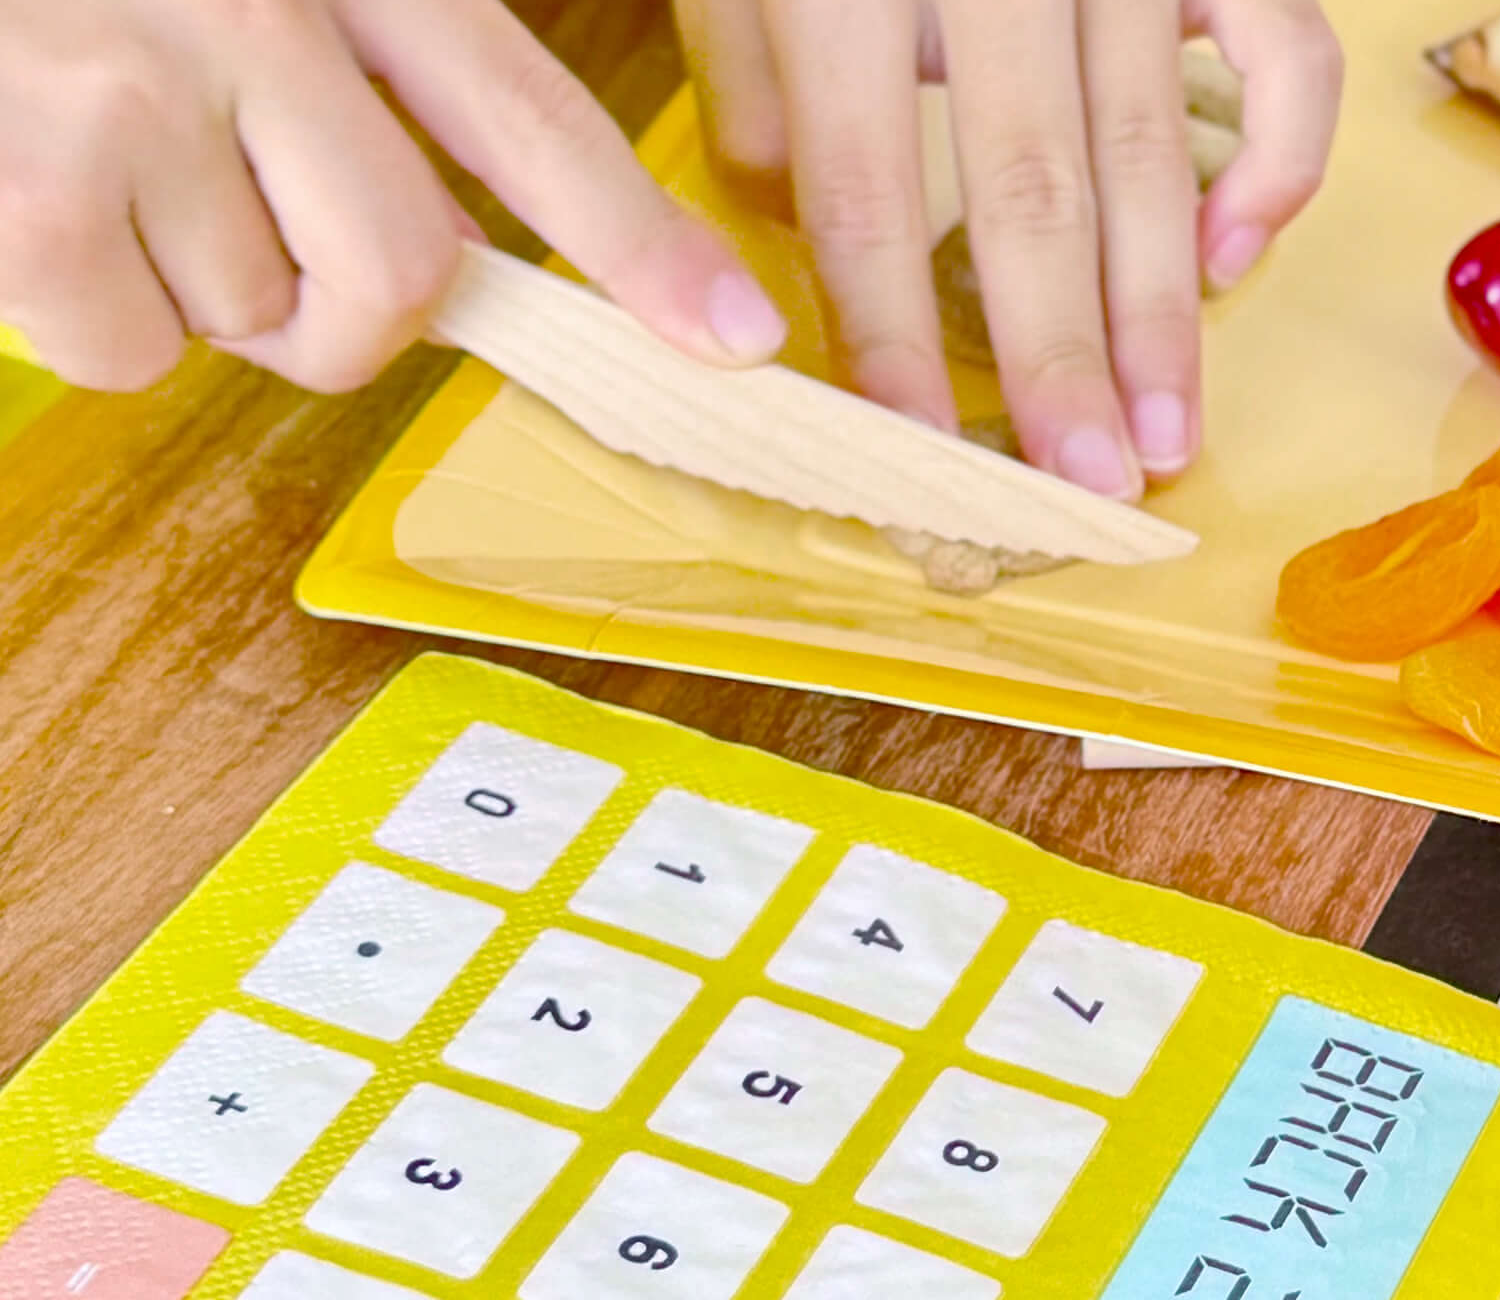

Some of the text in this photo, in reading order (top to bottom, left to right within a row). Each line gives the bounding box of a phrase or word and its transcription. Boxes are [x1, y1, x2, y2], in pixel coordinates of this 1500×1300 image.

[654, 860, 707, 886] 1
[852, 917, 904, 954] 4
[530, 996, 592, 1033] 2
[1052, 985, 1105, 1024] 7
[741, 1069, 804, 1106] 5
[942, 1138, 1000, 1174] 8
[1220, 1037, 1425, 1249] BACK
[404, 1156, 463, 1193] 3
[617, 1233, 679, 1272] 6
